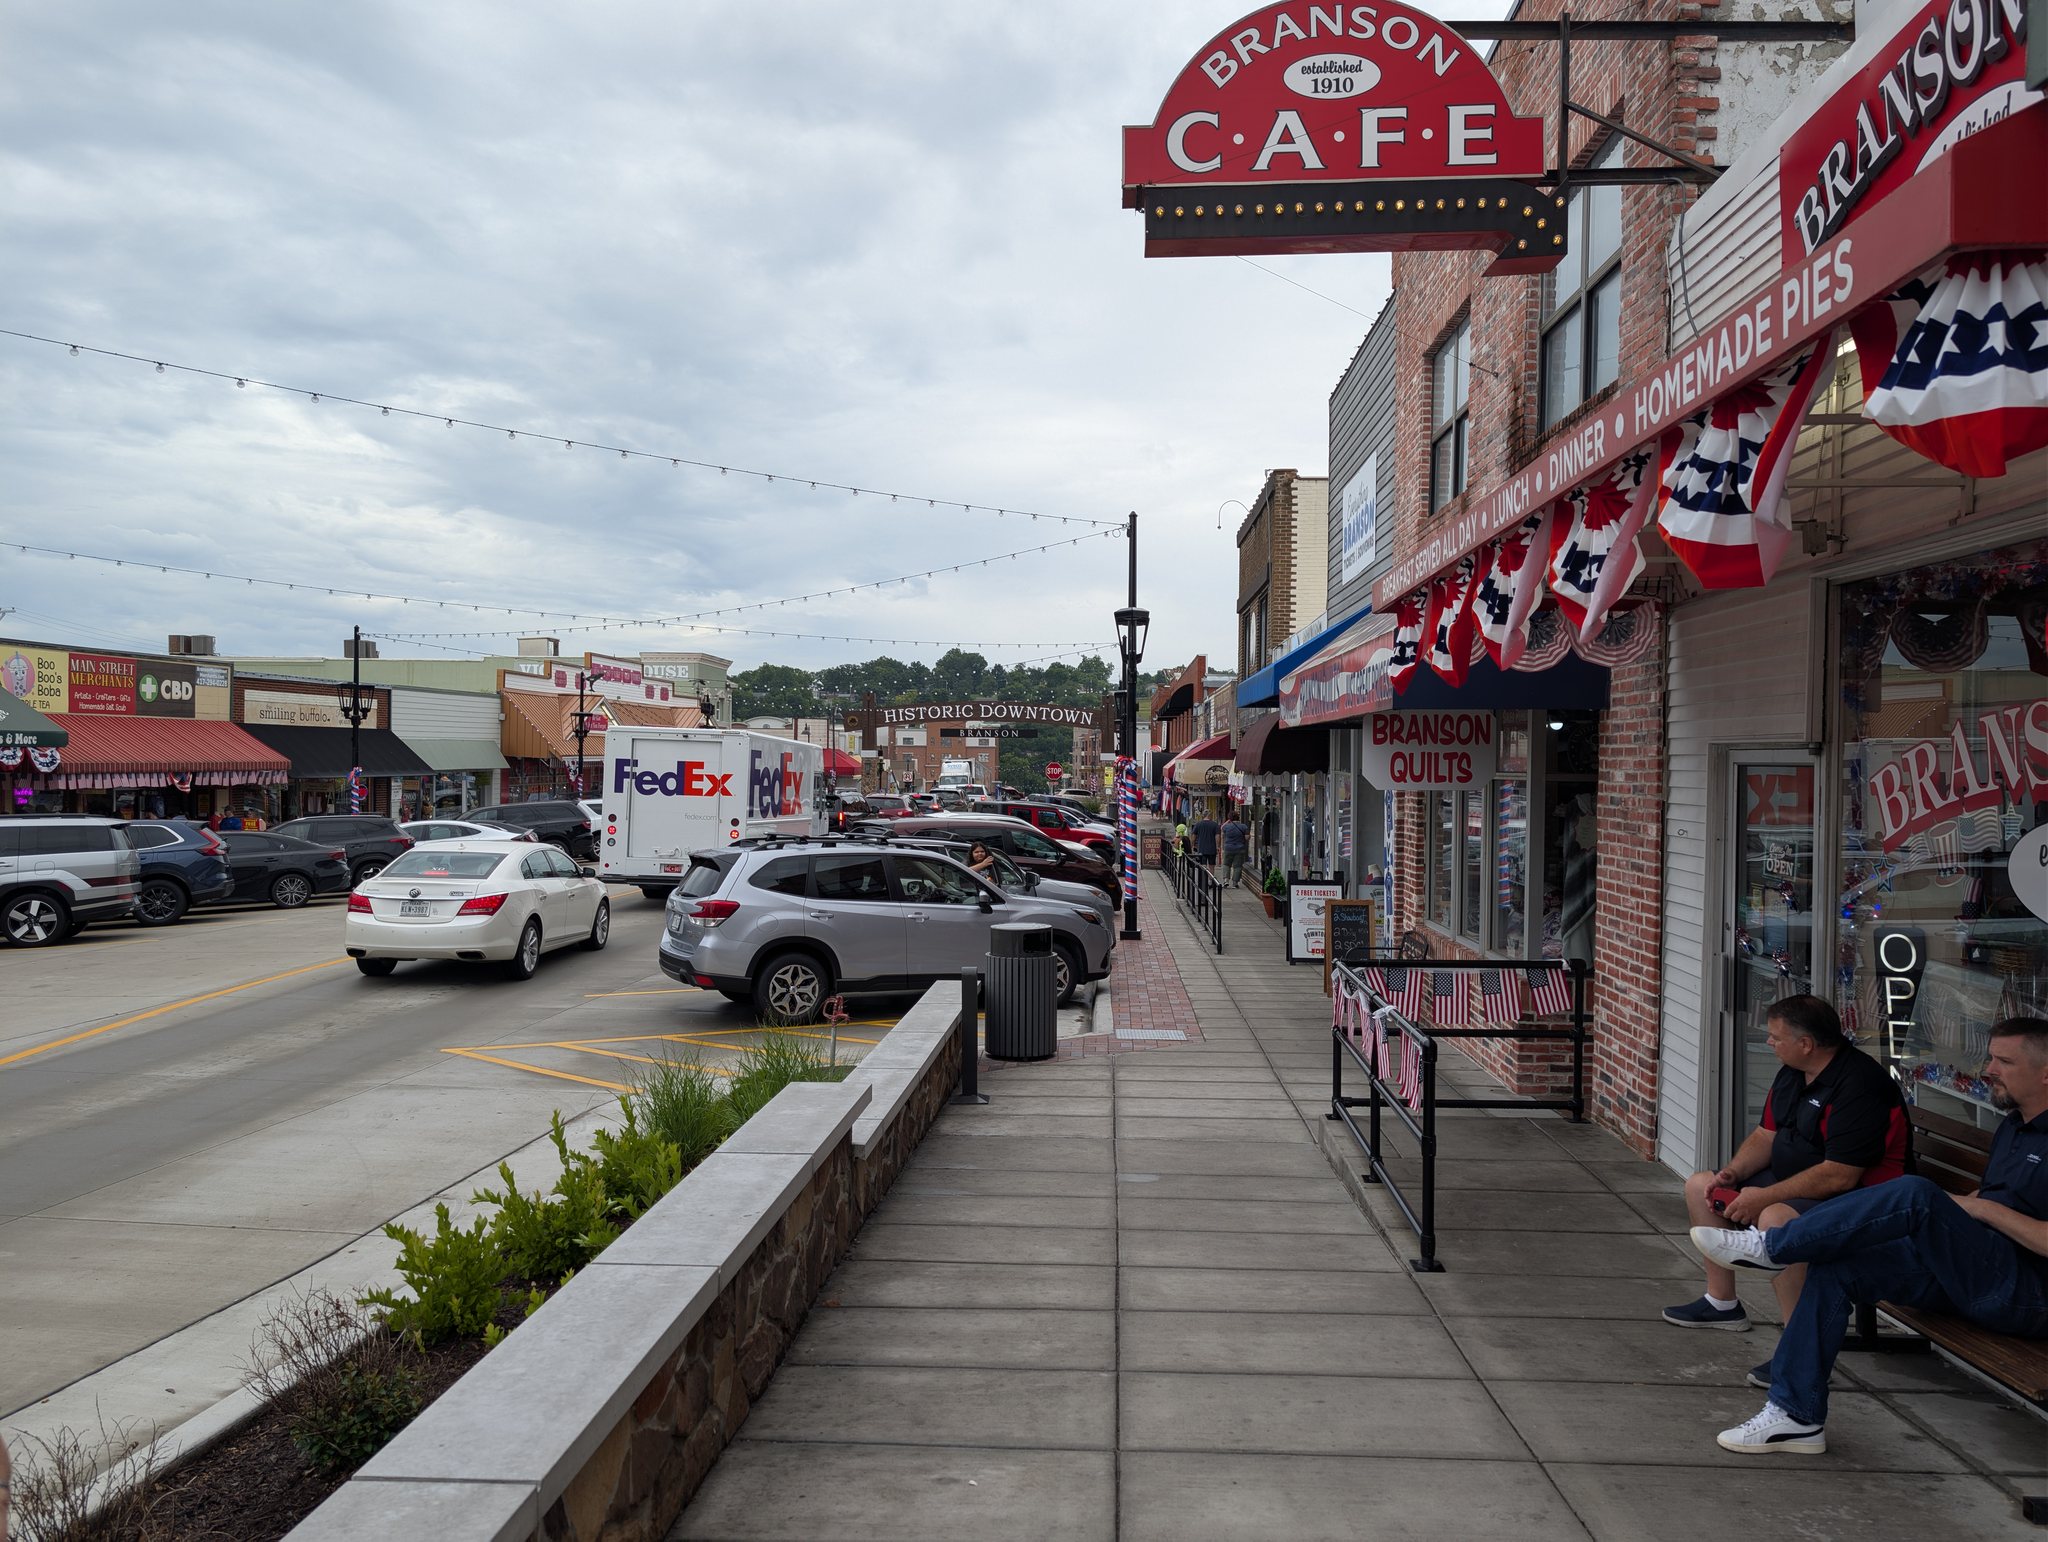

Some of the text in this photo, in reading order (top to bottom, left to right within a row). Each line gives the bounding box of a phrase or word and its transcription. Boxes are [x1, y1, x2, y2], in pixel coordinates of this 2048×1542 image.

[1200, 5, 1460, 89] BRANSON
[1300, 59, 1363, 76] established
[1310, 77, 1354, 94] 1910
[1635, 239, 1853, 435] HOMEMADE PIES
[1549, 419, 1605, 492] DINNER
[1492, 473, 1529, 529] LUNCH
[1343, 497, 1375, 553] BRANSON
[1382, 511, 1477, 601] BREAKFAST SERVED ALL DAY
[37, 657, 55, 670] Boo
[70, 659, 135, 676] MAIN STREET
[643, 665, 689, 678] OUSE
[37, 671, 62, 683] Boo's
[70, 672, 134, 689] MERCHANTS
[37, 684, 61, 697] Boba
[160, 679, 193, 700] CBD
[39, 700, 51, 709] TEA
[79, 702, 105, 711] Homemade
[259, 708, 296, 723] smiling
[884, 703, 1094, 725] HISTORIC DOWNTOWN
[959, 729, 1019, 738] BRANSON
[1372, 713, 1491, 746] BRANSON
[6, 733, 13, 744] &
[15, 733, 38, 745] More
[1046, 764, 1062, 775] STOP
[1390, 751, 1473, 784] QUILTS
[614, 758, 734, 797] FedEx
[749, 750, 803, 818] FedEx
[684, 813, 717, 821] fedex.com
[1766, 859, 1794, 876] OPEN
[1296, 889, 1300, 897] 2
[1301, 889, 1313, 897] FREE
[1303, 929, 1326, 939] DOWNTO
